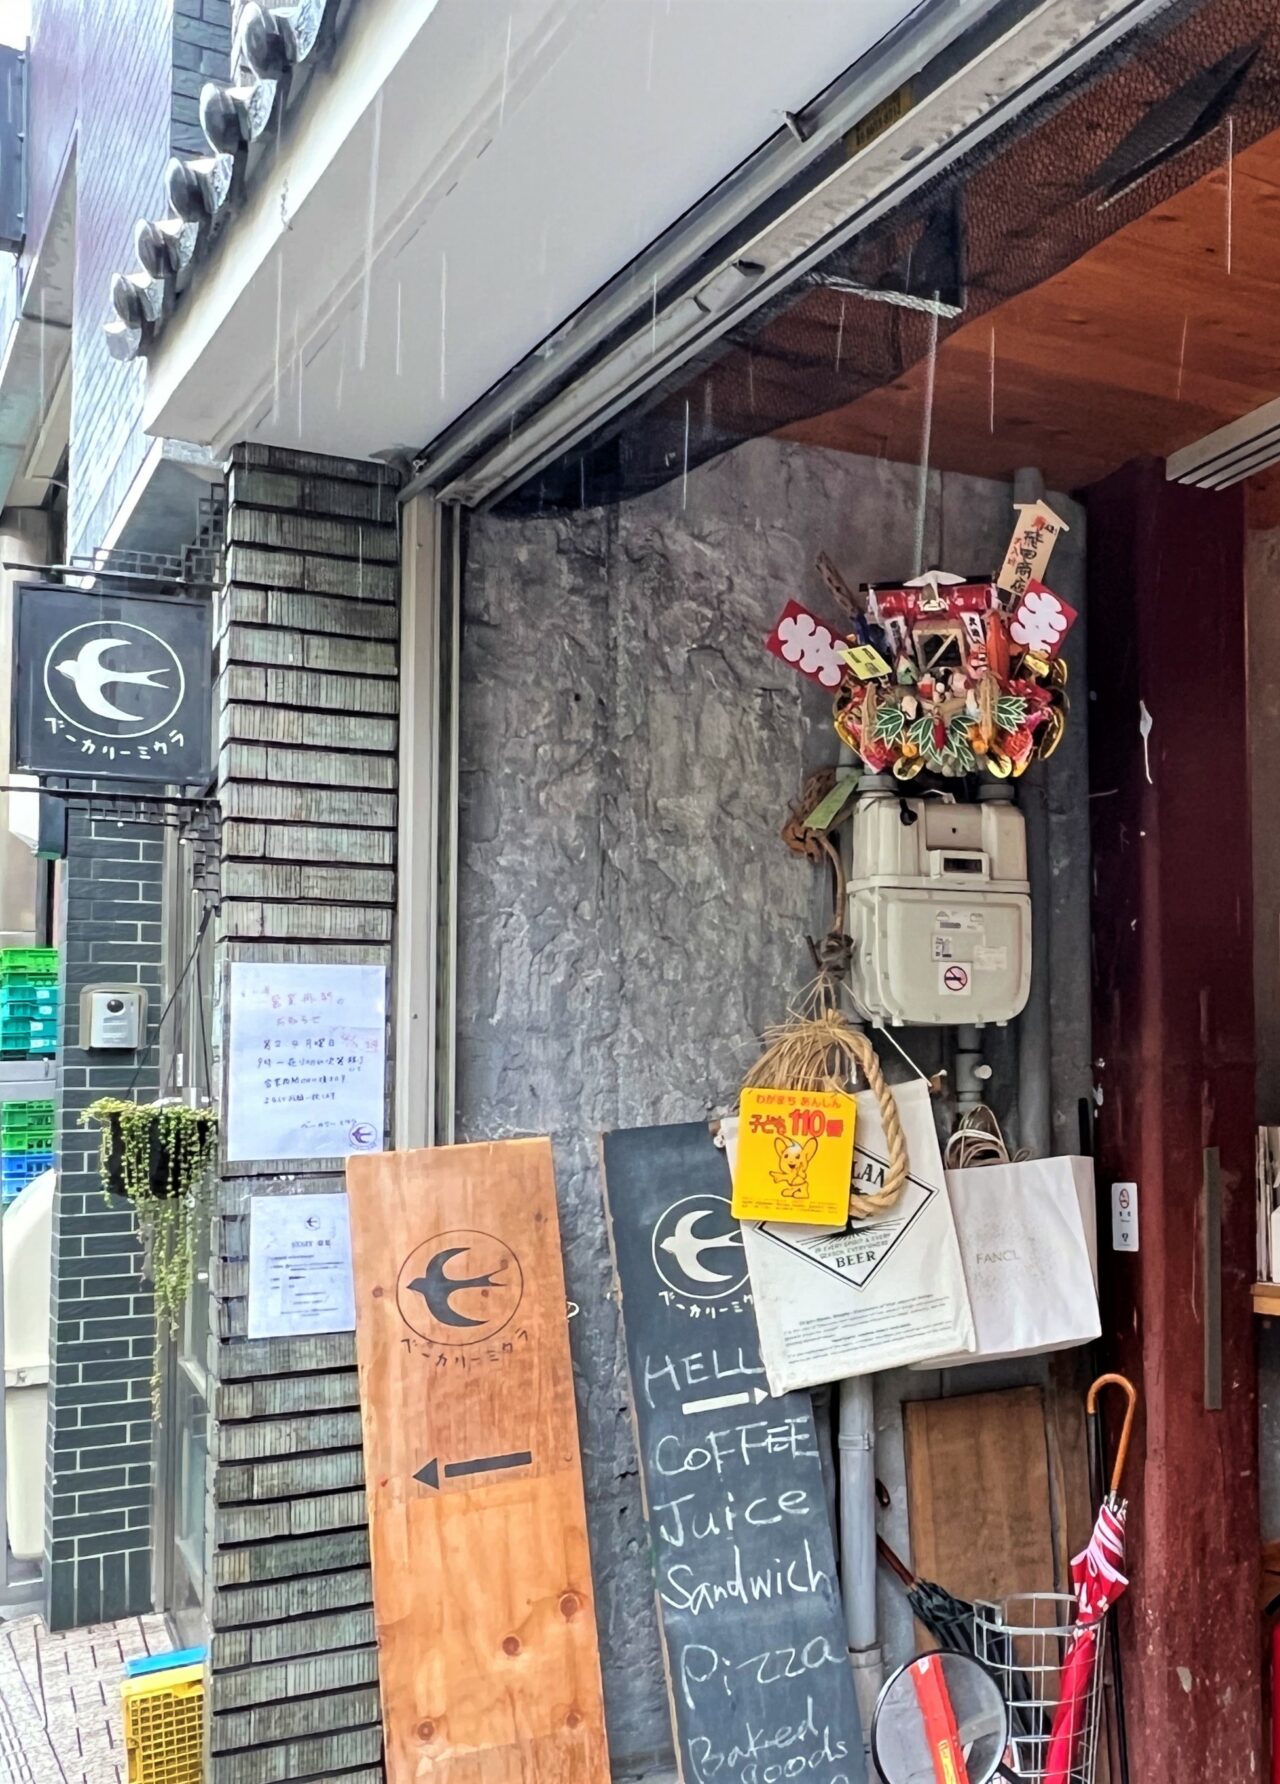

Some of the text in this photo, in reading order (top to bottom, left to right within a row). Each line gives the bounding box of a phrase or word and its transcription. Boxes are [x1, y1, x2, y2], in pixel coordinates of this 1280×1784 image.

[757, 1094, 842, 1109] わがまち あんしん
[836, 1250, 877, 1269] BEER
[976, 1249, 1021, 1265] FANCL
[653, 1489, 810, 1547] Juice
[661, 1537, 832, 1616] Sandwich
[680, 1636, 847, 1710] Pizza
[688, 1695, 818, 1784] Baked
